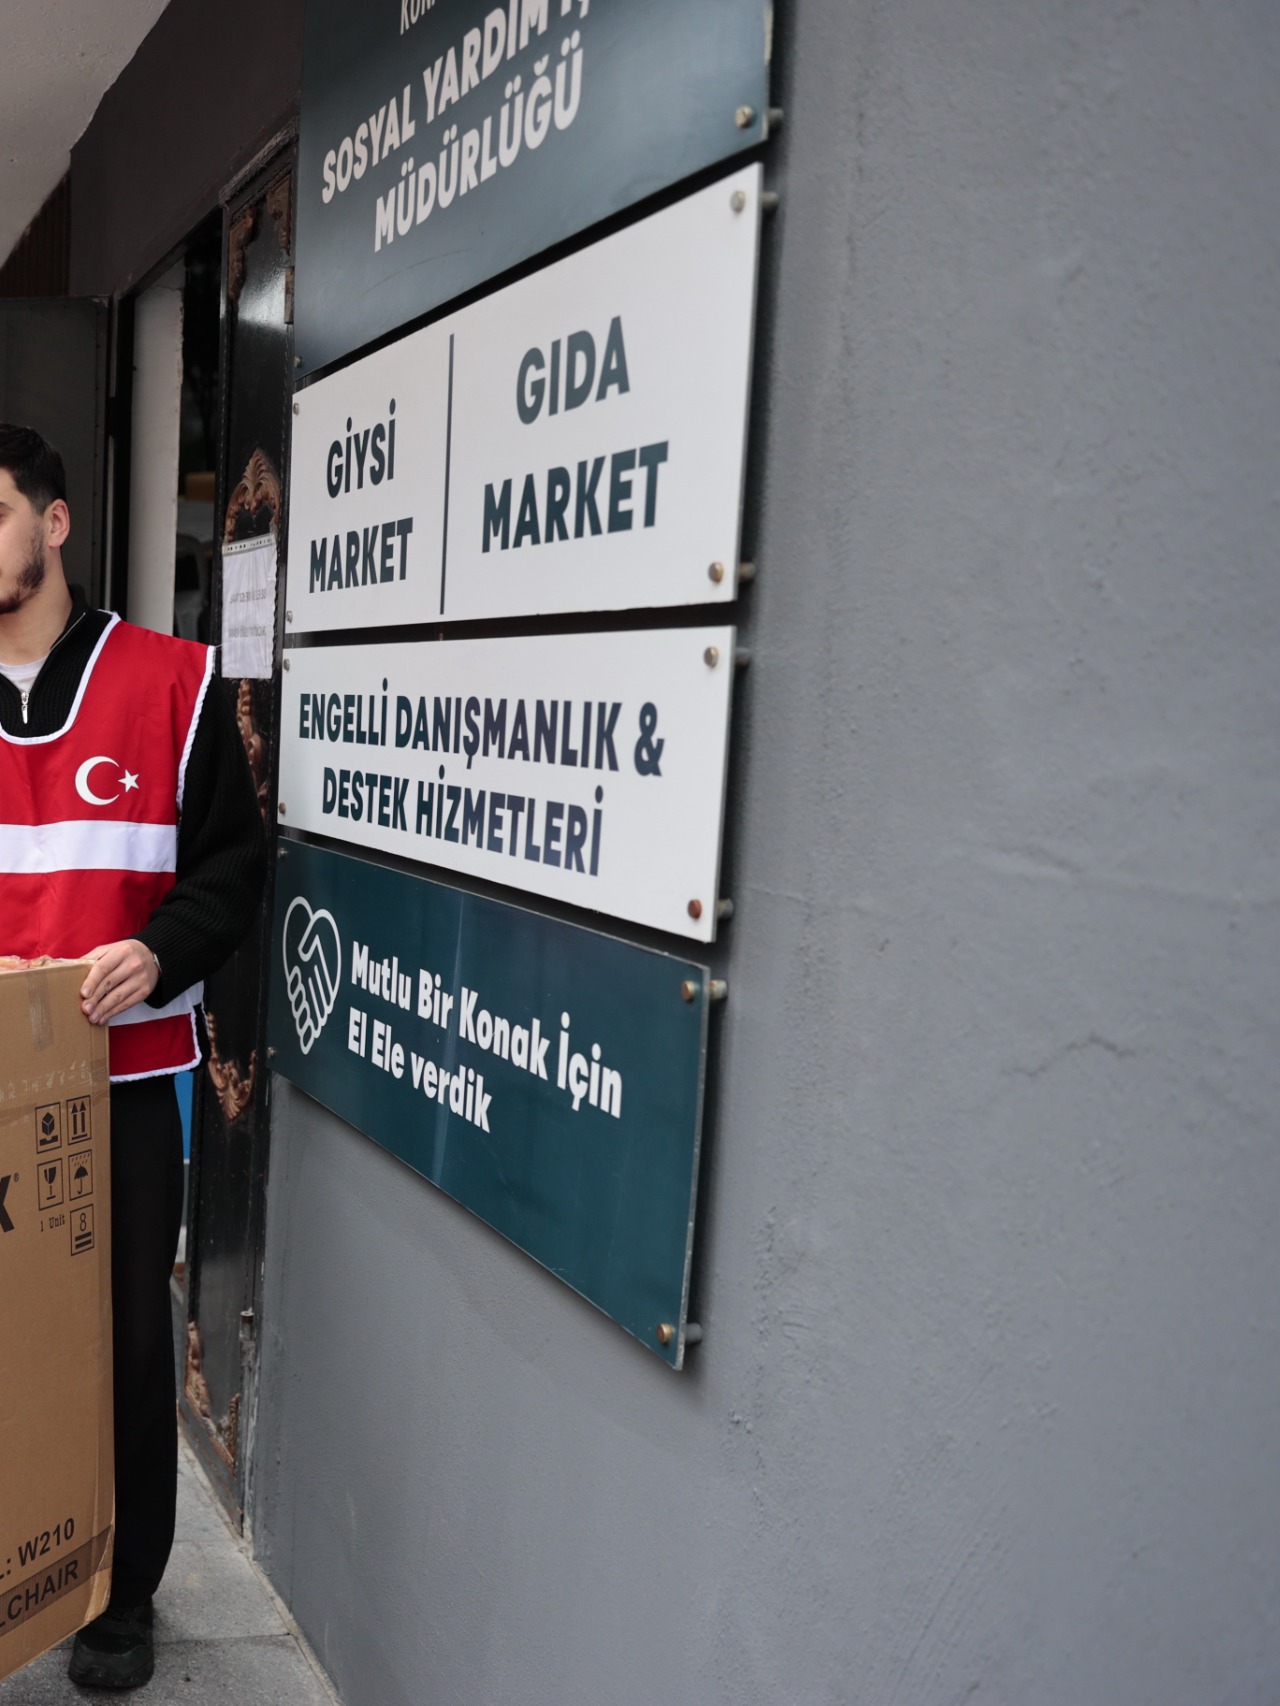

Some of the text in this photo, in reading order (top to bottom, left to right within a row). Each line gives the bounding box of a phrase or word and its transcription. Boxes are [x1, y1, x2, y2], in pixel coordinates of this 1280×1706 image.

[322, 0, 549, 203] SOSYAL YARDIM
[374, 29, 584, 253] MÜDÜRLÜĞÜ
[516, 315, 631, 425] GIDA
[326, 397, 396, 498] GİYSİ
[481, 440, 669, 554] MARKET
[309, 516, 414, 594] MARKET
[299, 677, 665, 777] ENGELLİ DANIŞMANLIK &
[322, 764, 603, 878] DESTEK HİZMETLERİ
[347, 1006, 493, 1134] El Ele verdik
[351, 940, 623, 1120] Mutlu Bir Konak İçin
[79, 1212, 87, 1232] 8
[18, 1518, 75, 1567] W210
